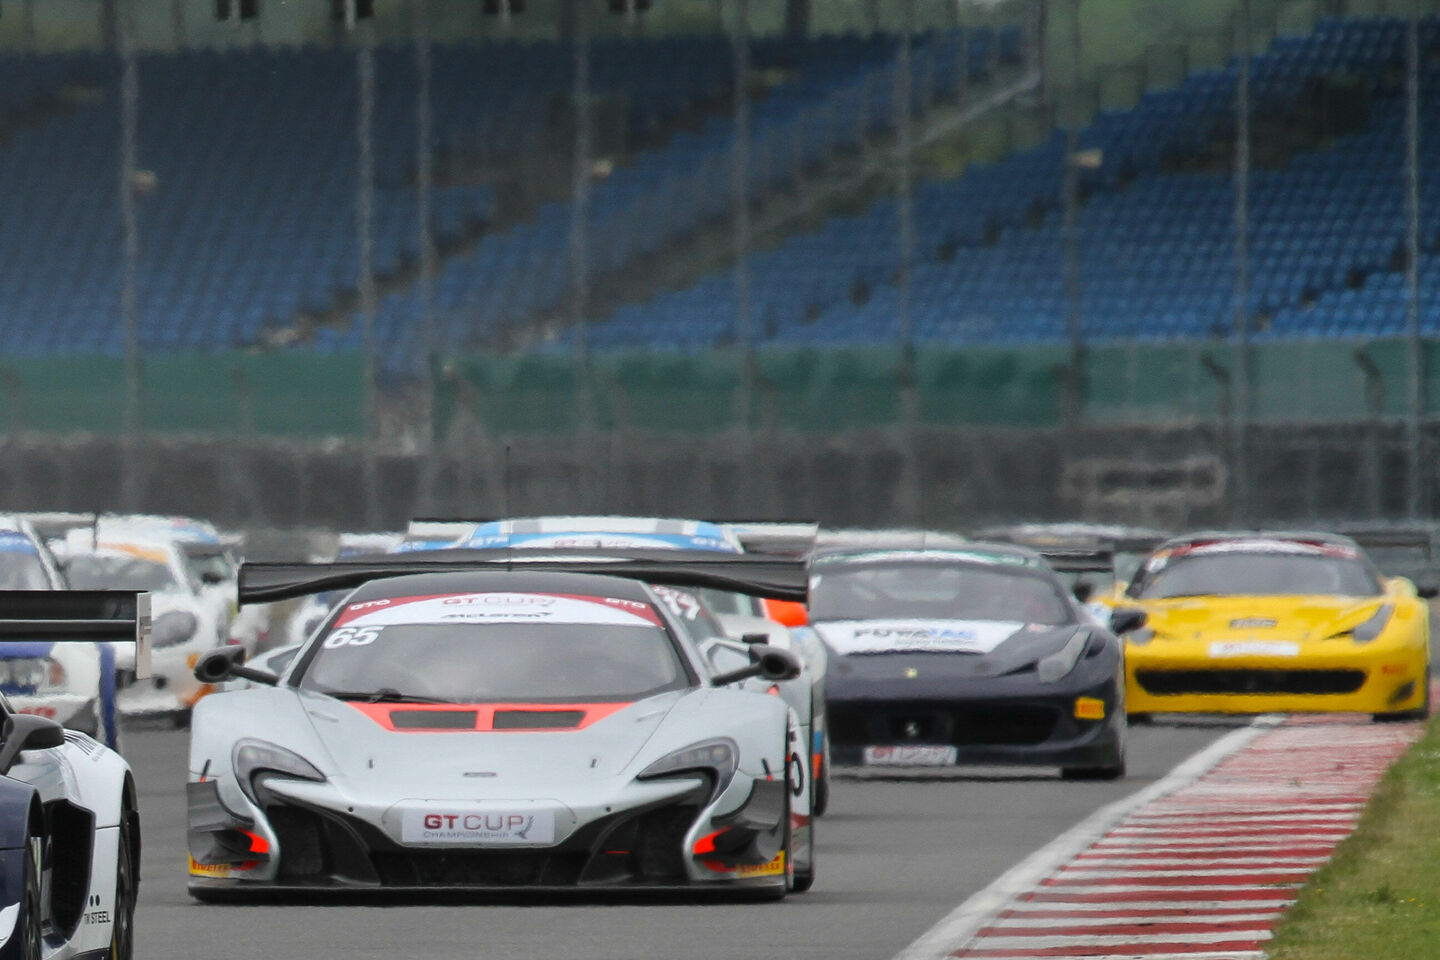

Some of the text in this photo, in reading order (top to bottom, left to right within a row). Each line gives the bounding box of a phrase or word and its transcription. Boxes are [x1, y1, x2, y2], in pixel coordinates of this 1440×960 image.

[349, 599, 391, 611] GTO
[604, 597, 647, 609] GTO
[323, 626, 384, 650] 65
[424, 813, 524, 831] GT CUP
[90, 910, 111, 924] STEEL
